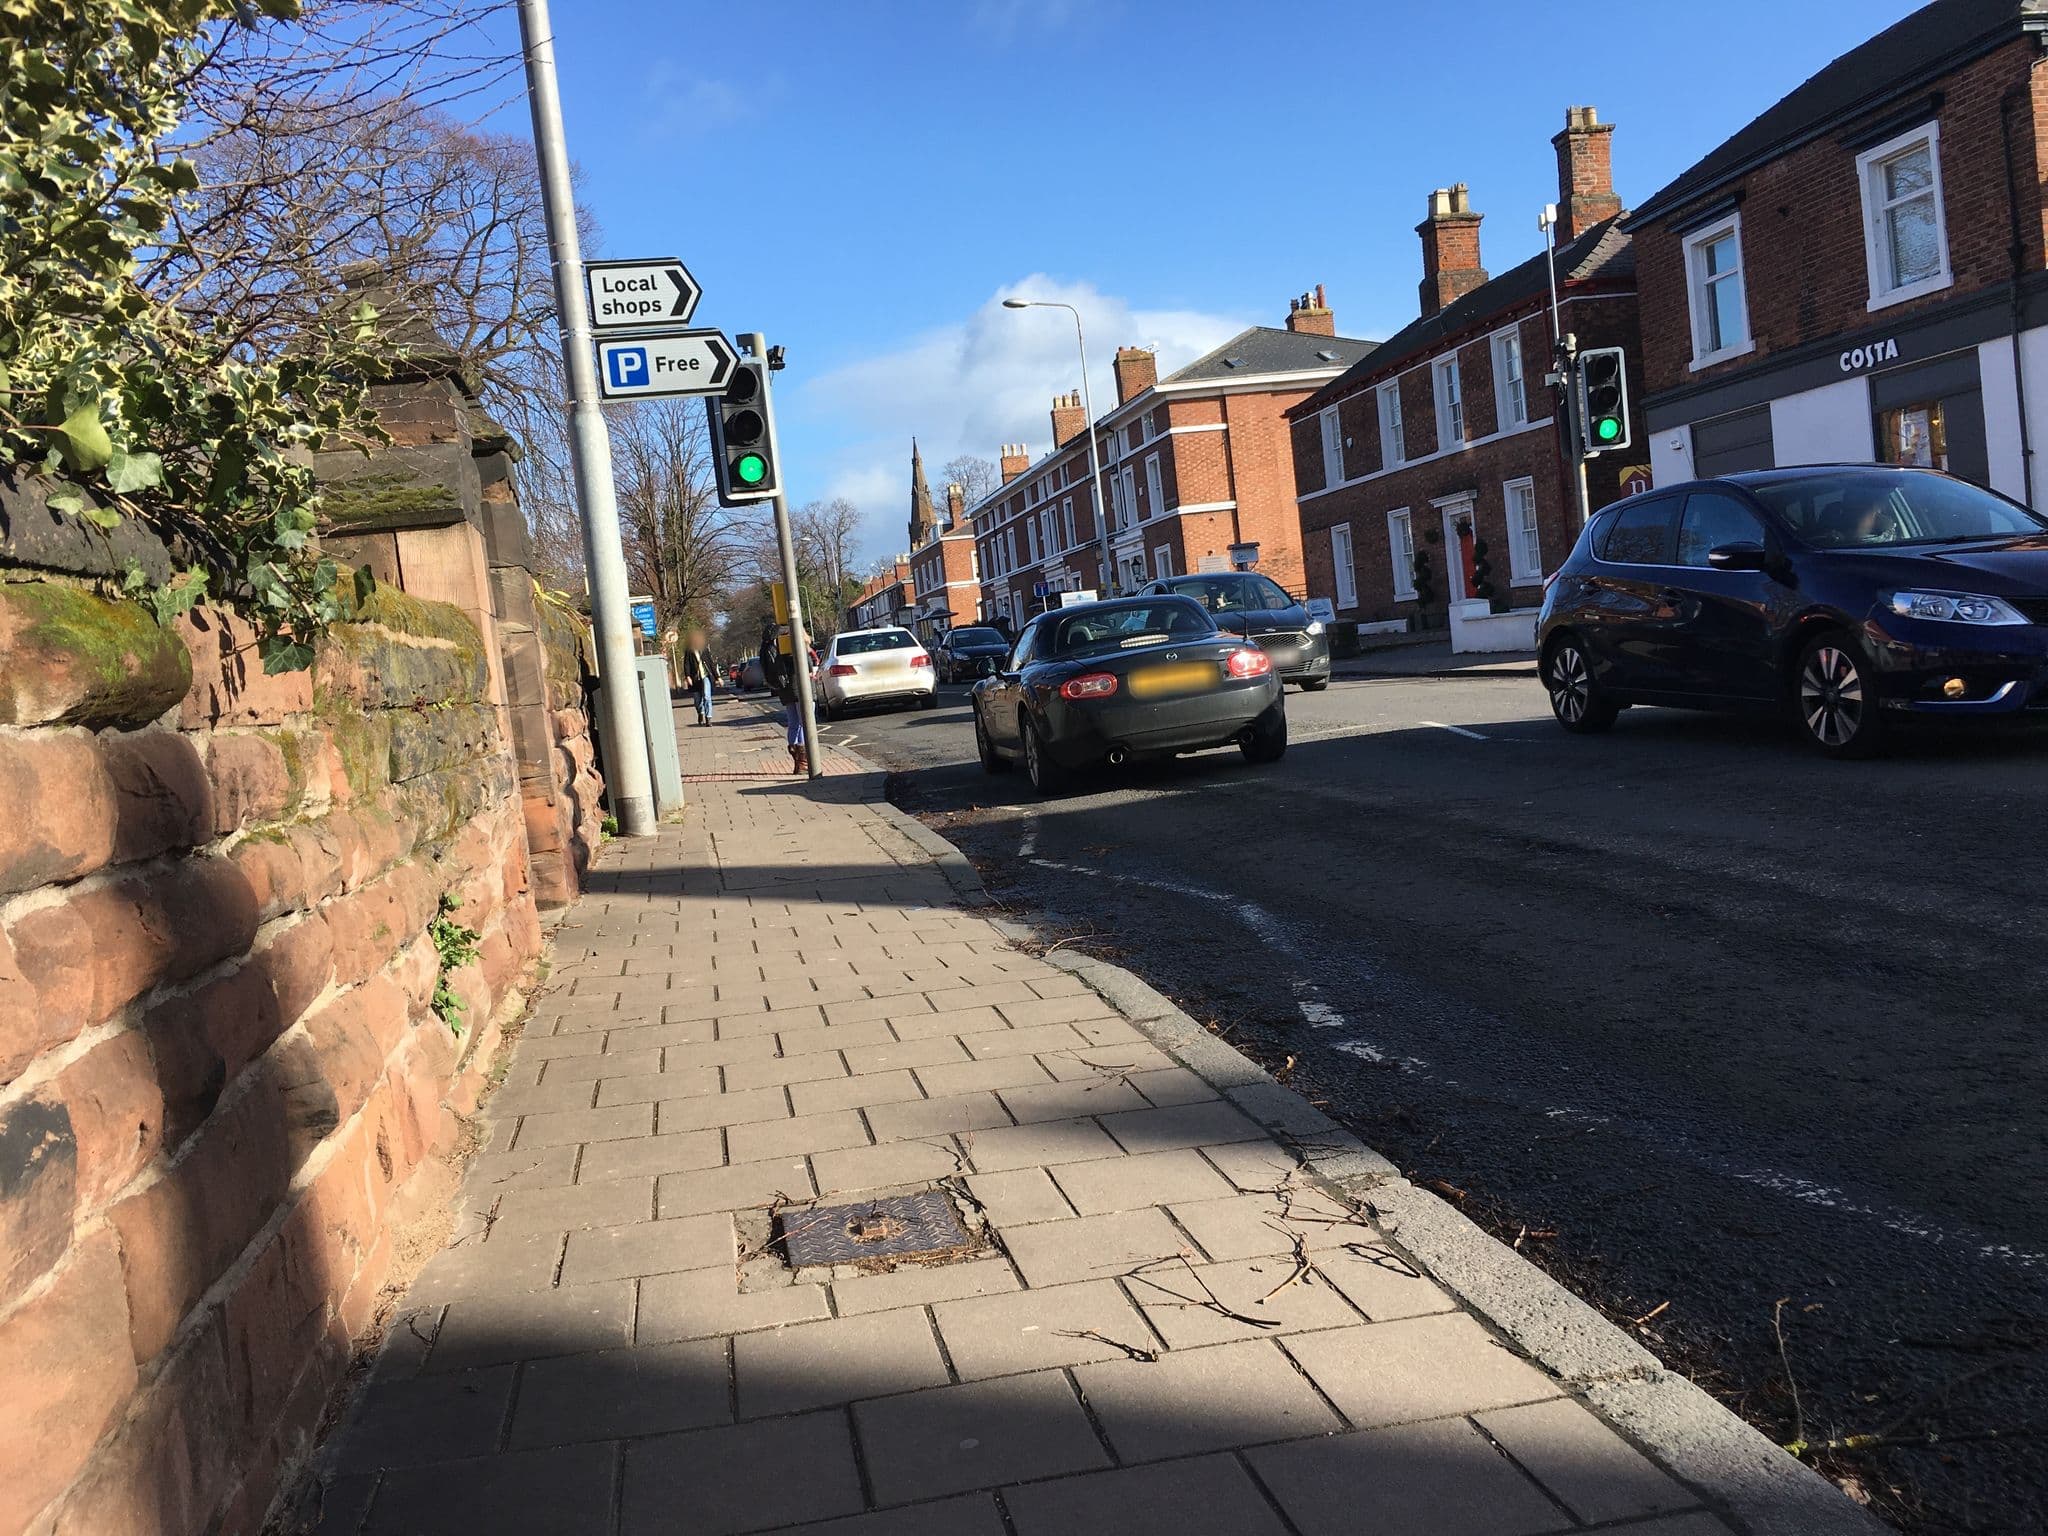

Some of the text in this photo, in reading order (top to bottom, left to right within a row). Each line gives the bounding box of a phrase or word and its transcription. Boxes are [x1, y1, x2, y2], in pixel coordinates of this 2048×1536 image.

[602, 274, 657, 293] Local
[602, 298, 662, 316] shops
[1840, 338, 1899, 372] COSTA
[617, 352, 700, 384] P Free
